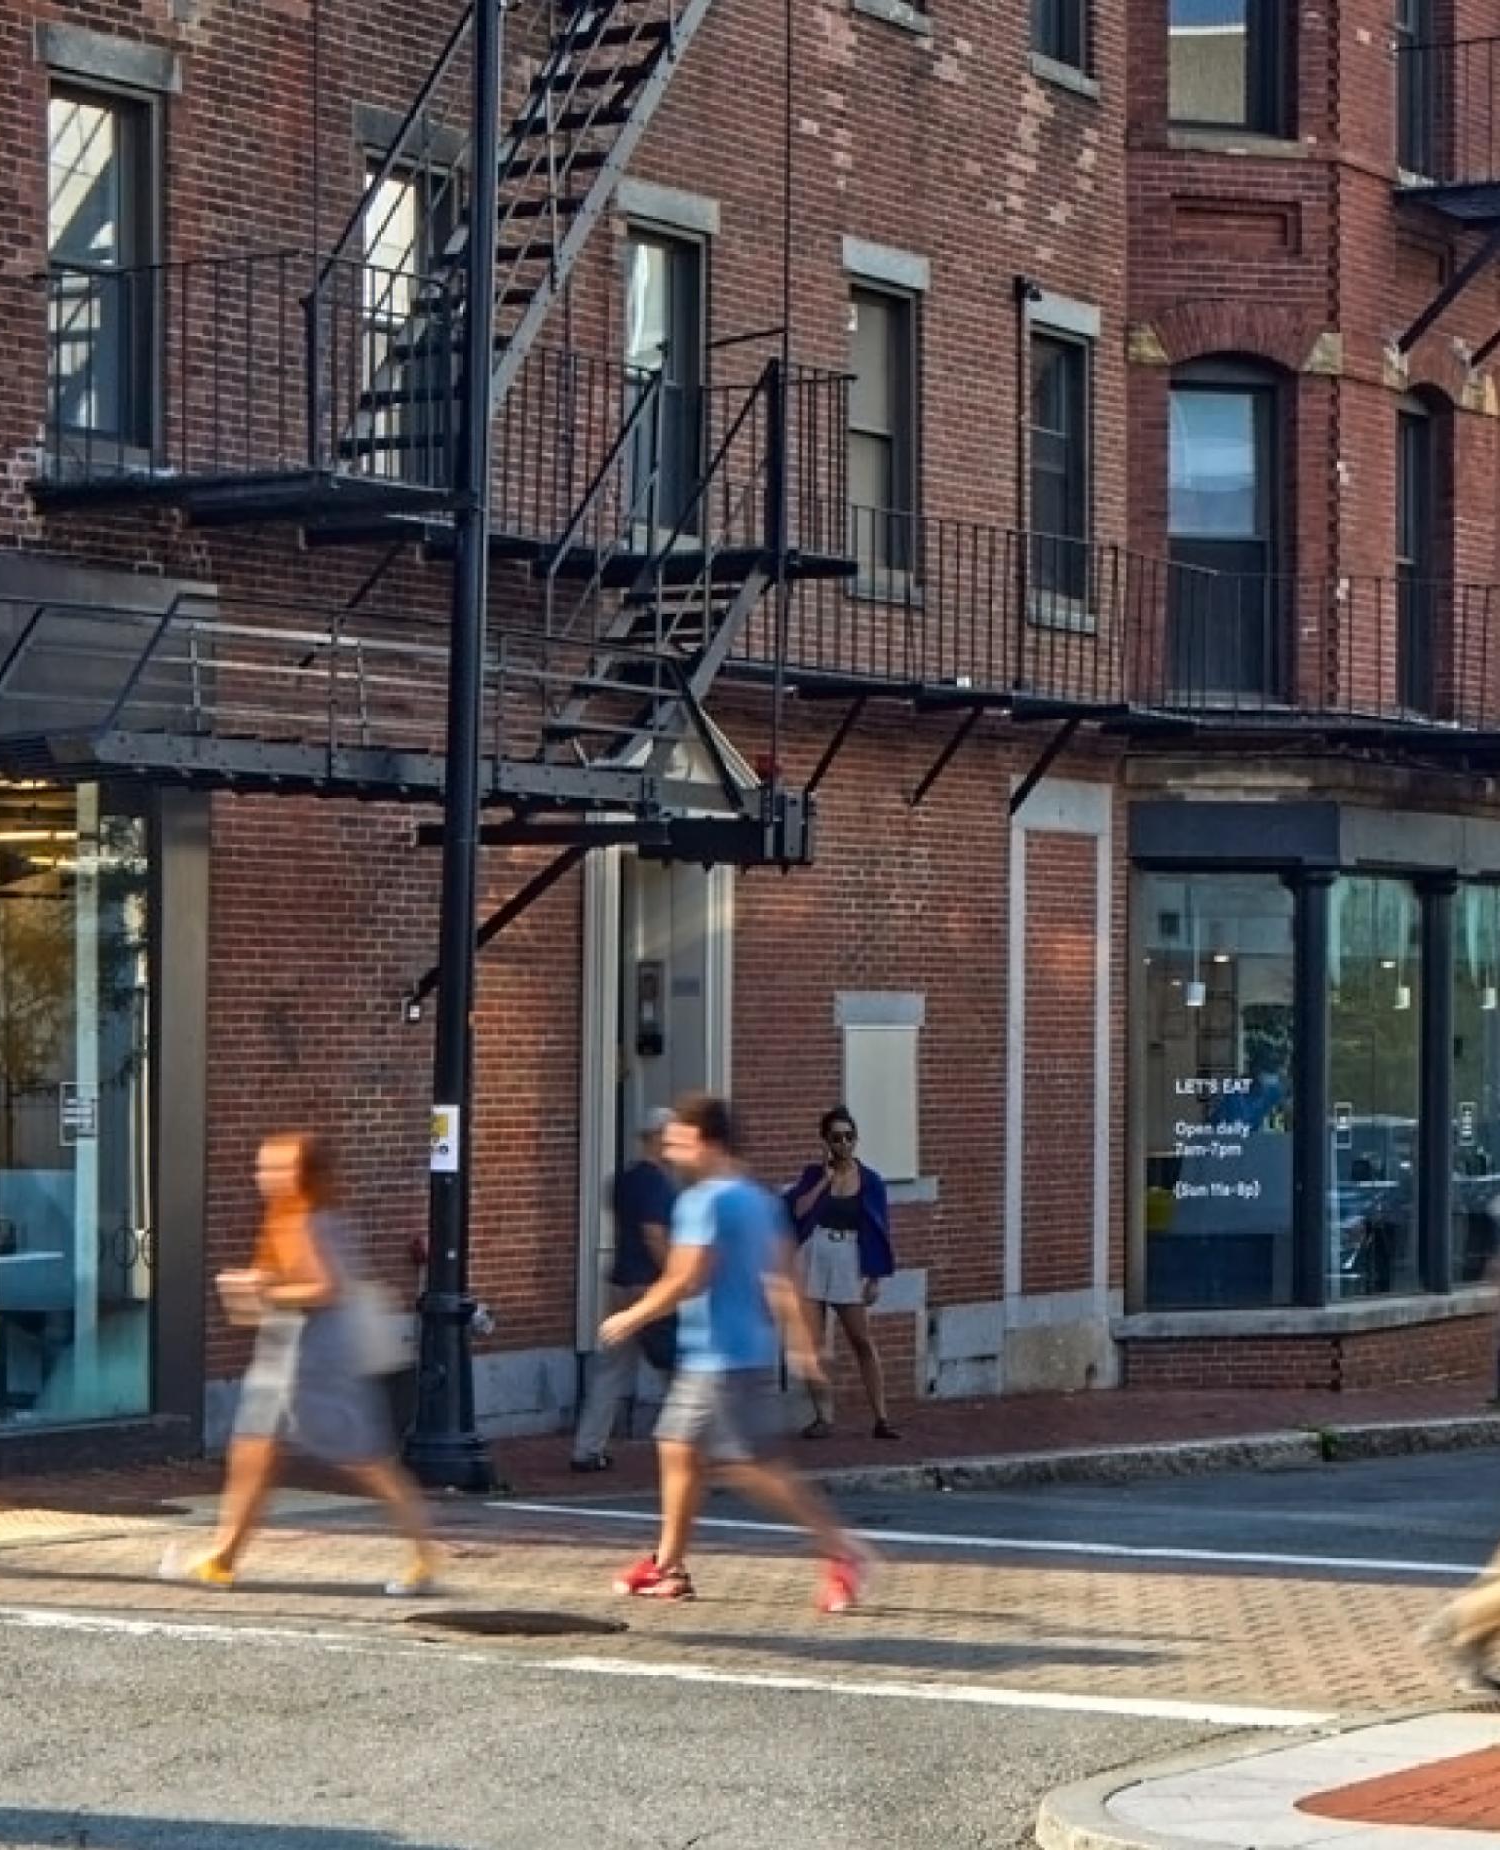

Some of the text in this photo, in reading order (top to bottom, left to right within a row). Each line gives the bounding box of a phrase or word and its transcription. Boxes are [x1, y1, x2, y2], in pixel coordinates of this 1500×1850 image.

[1175, 1078, 1253, 1095] LET'S EAT
[1175, 1119, 1251, 1138] Open daily
